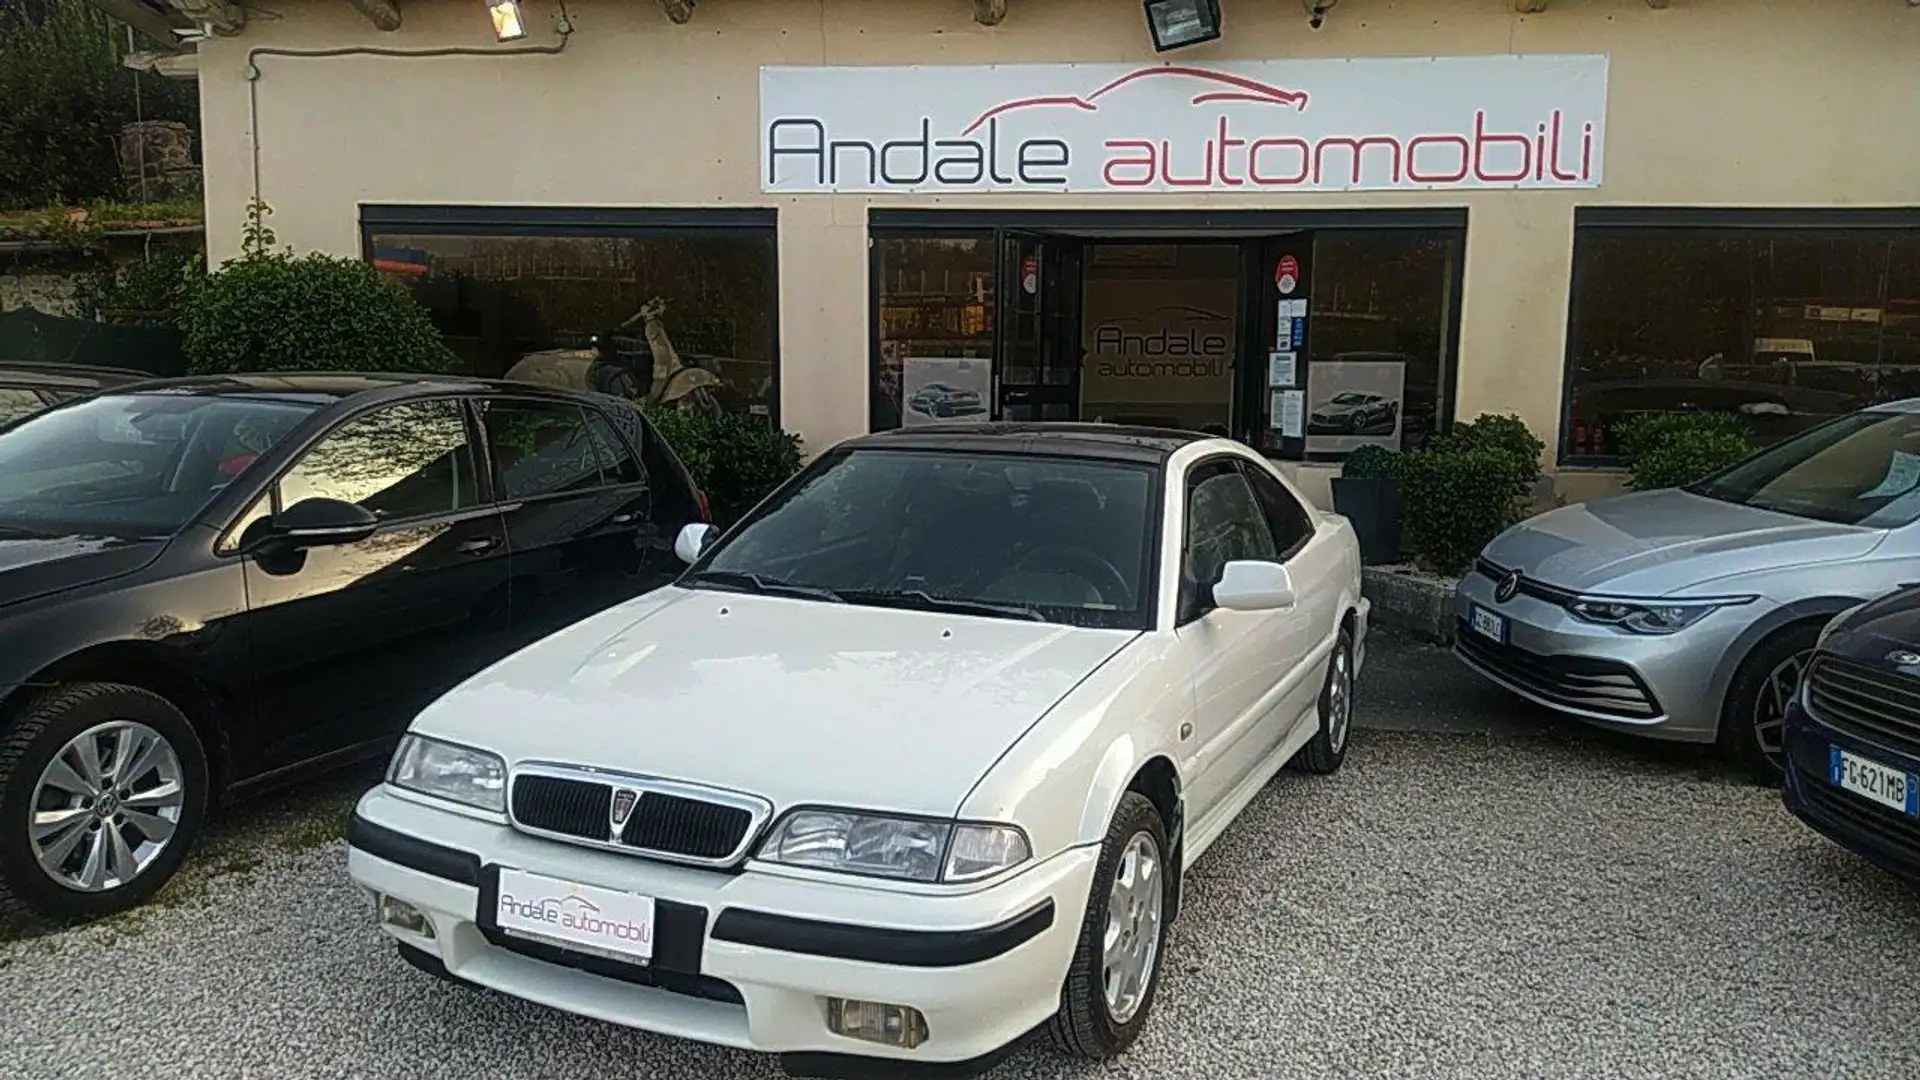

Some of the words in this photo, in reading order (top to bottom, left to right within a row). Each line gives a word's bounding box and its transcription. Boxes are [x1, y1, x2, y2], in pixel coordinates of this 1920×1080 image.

[769, 117, 1069, 185] Andale
[1104, 110, 1593, 186] automobili
[1096, 326, 1226, 356] Andale
[1098, 357, 1224, 377] automobili
[501, 894, 558, 923] Andale
[563, 911, 650, 943] automobili
